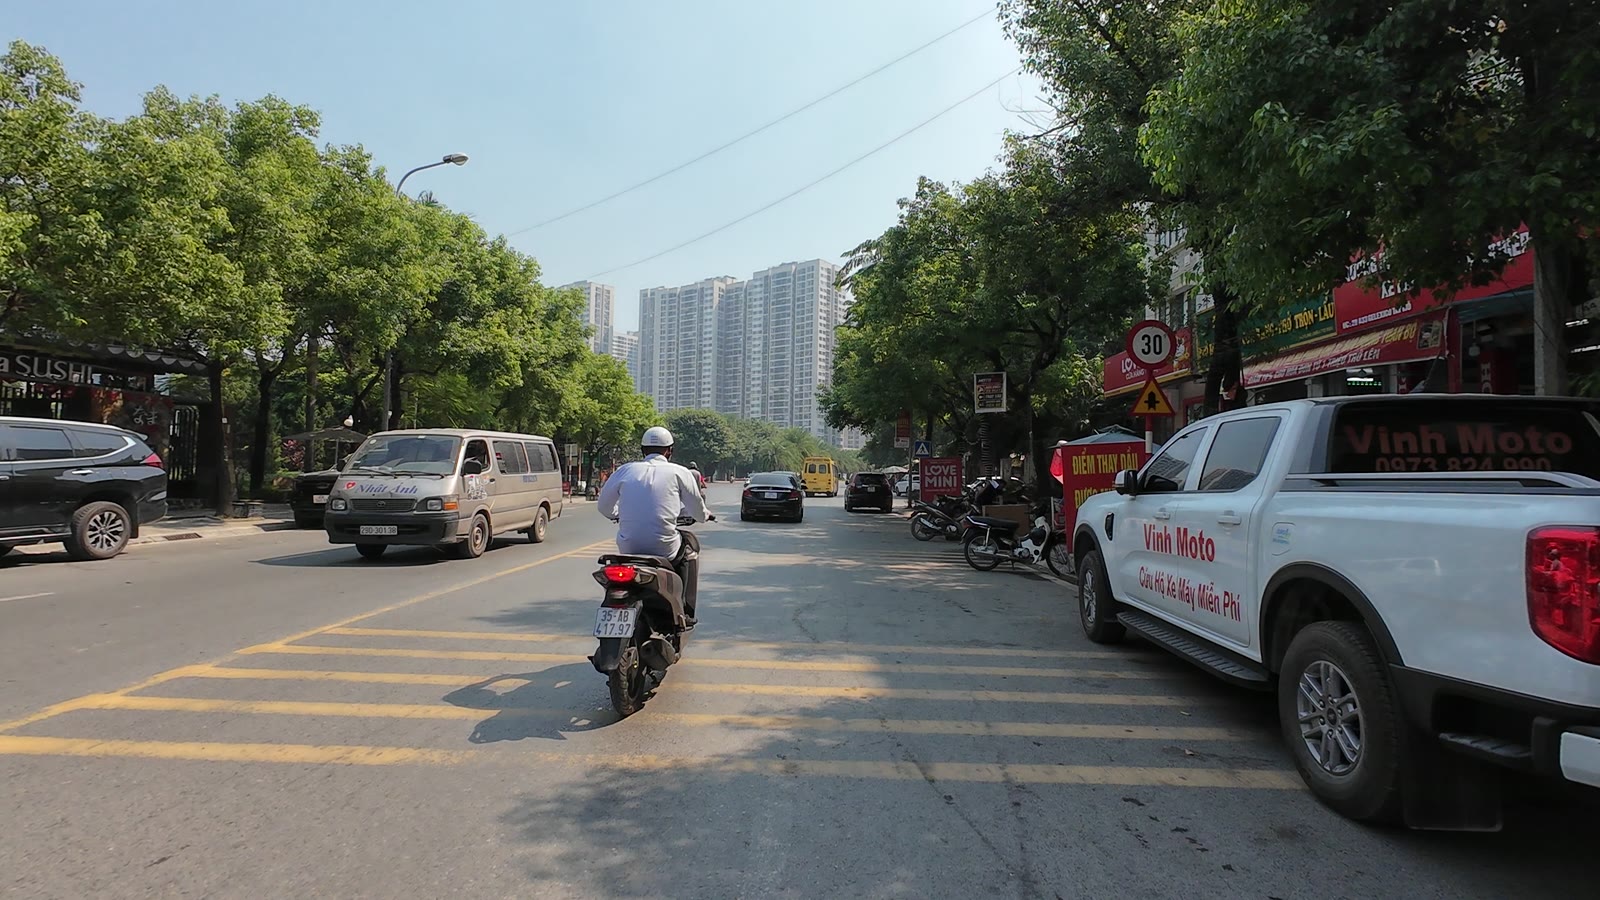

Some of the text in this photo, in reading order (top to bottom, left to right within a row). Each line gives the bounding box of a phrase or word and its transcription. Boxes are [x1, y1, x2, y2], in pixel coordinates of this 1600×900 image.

[1294, 307, 1314, 330] TRỘN
[1141, 334, 1163, 355] 30
[15, 354, 93, 384] SUSHI
[133, 405, 158, 426] なま
[1344, 424, 1572, 454] Vinh Moto
[924, 465, 957, 476] LOVE
[1072, 447, 1095, 475] ĐIỂM
[1096, 453, 1118, 474] THAY
[924, 476, 957, 488] MINI
[1143, 523, 1215, 562] Vinh Moto
[1166, 574, 1176, 599] Xe
[1178, 577, 1195, 611] Máy
[1198, 581, 1221, 614] Miễn
[1223, 590, 1241, 622] Phí
[601, 610, 629, 622] 35-AB
[595, 623, 631, 635] 417.97
